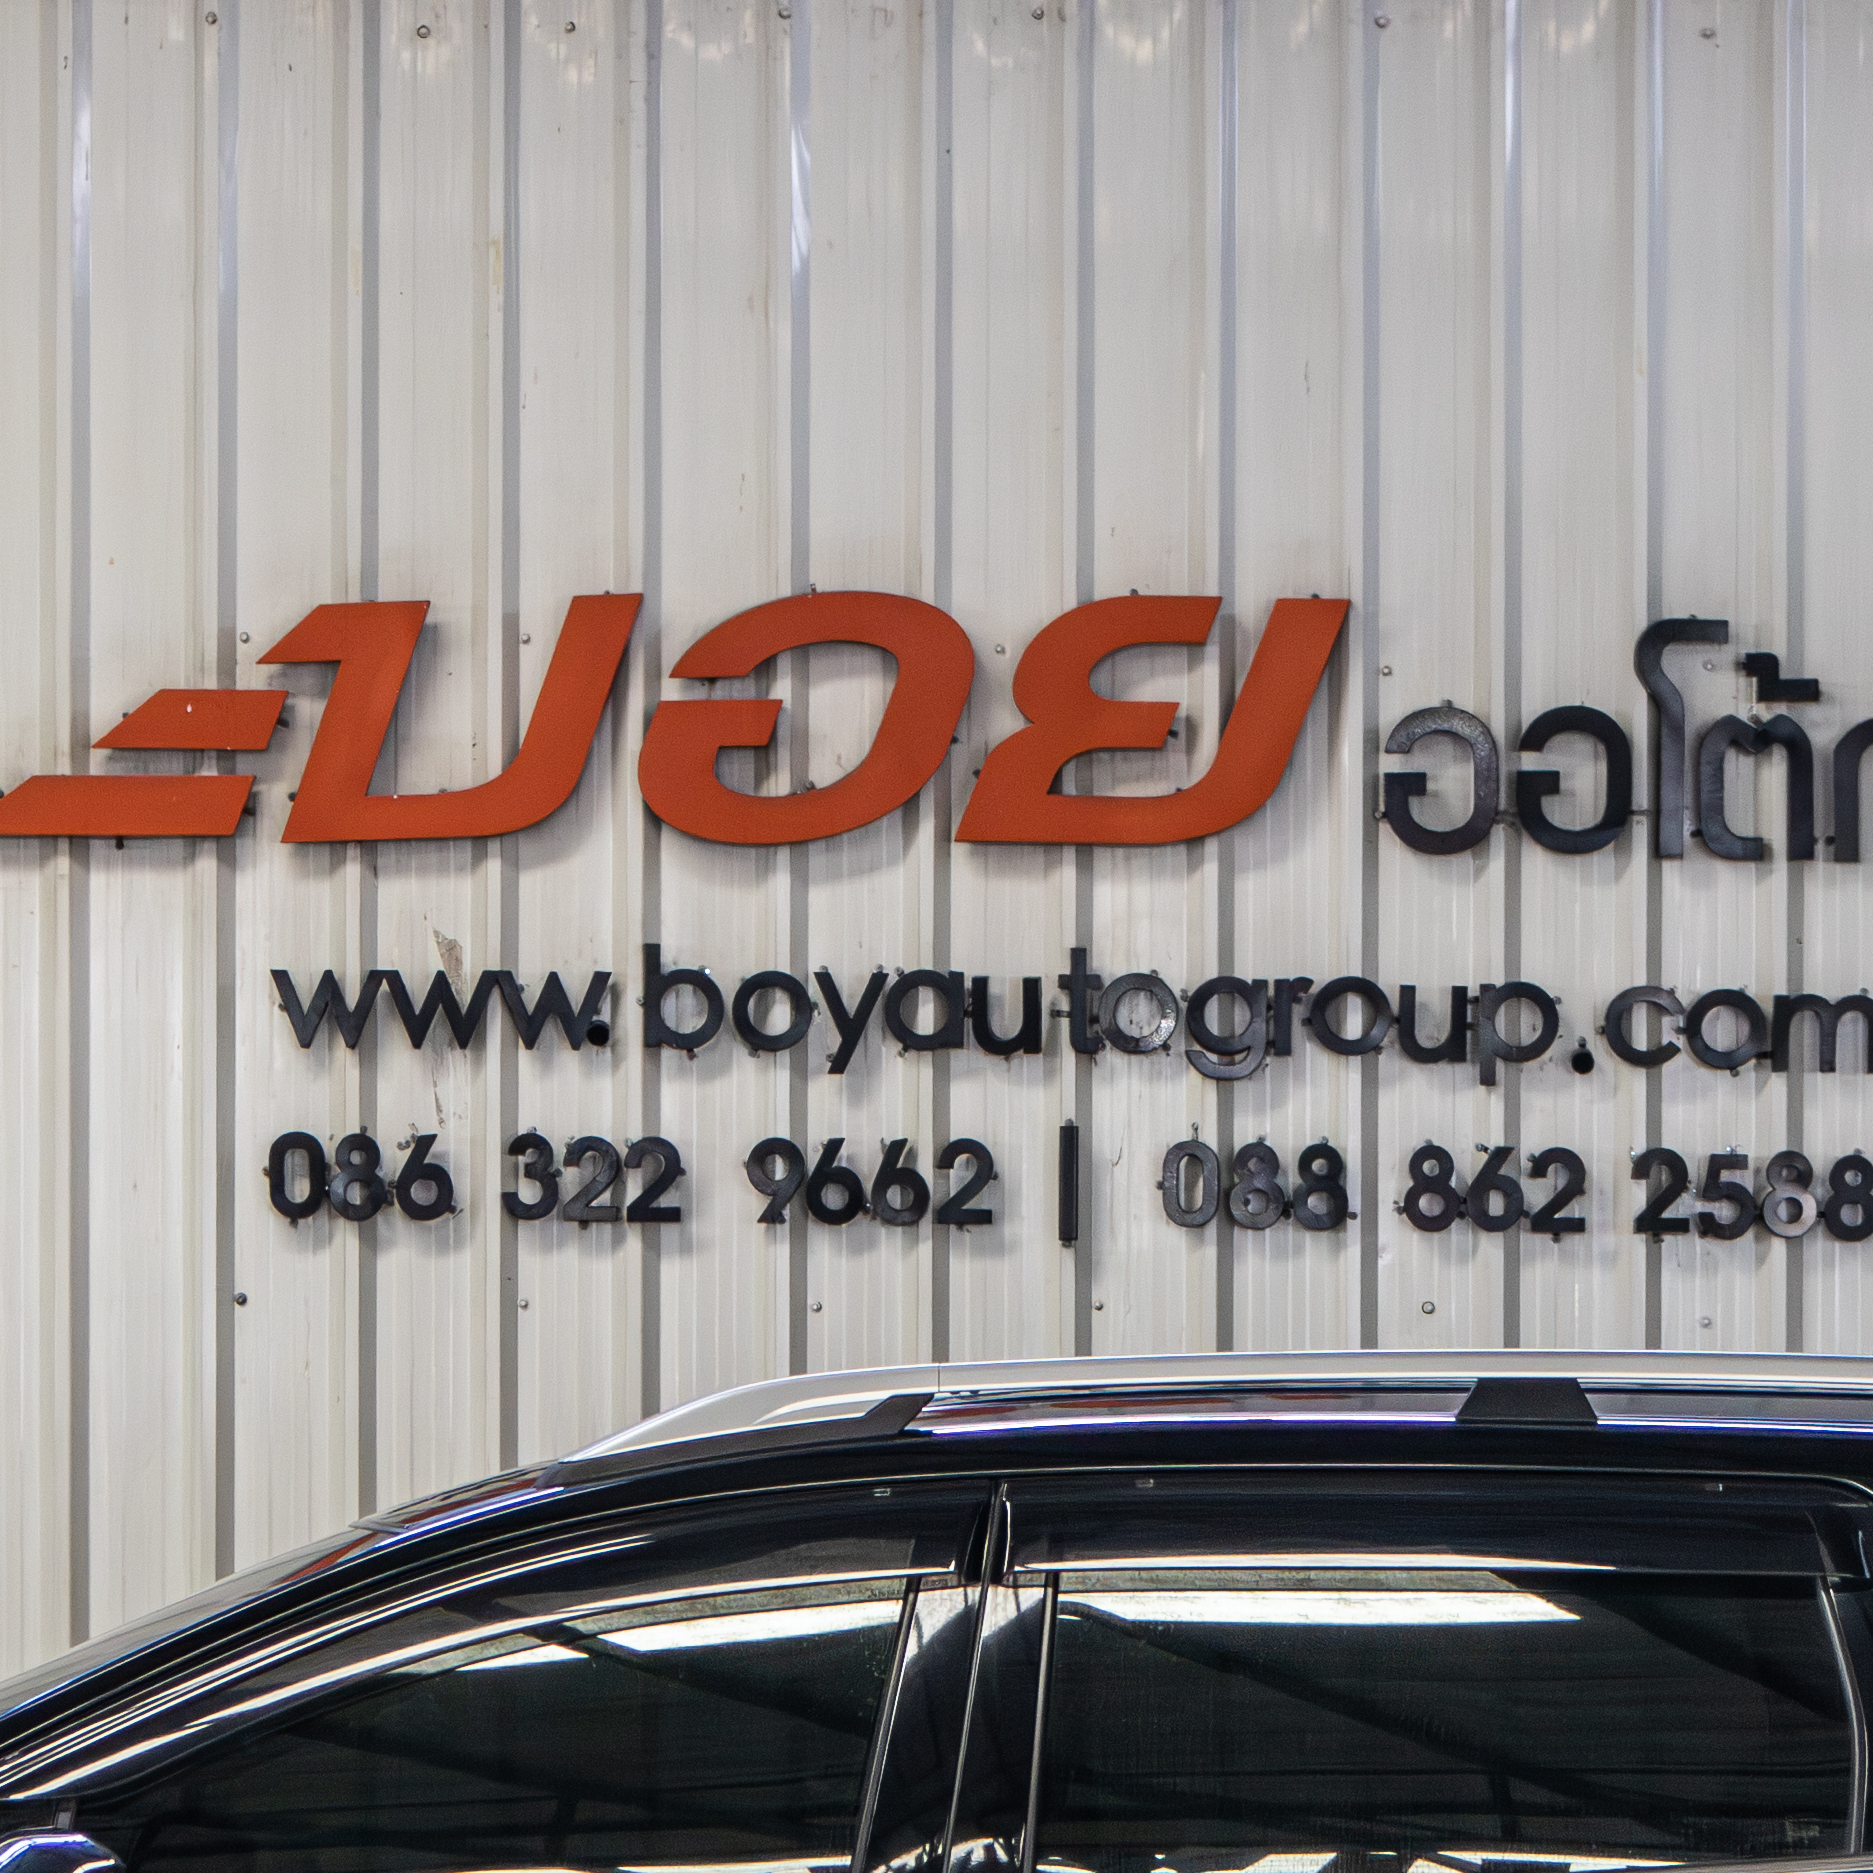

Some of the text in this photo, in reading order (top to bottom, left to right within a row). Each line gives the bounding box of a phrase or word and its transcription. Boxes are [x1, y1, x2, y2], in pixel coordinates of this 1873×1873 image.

[257, 592, 1351, 845] บอย
[266, 1130, 457, 1226] 086
[501, 1132, 685, 1228] 322
[746, 1137, 996, 1229] 9662
[1162, 1138, 1349, 1232] 088
[1403, 1143, 1586, 1238] 862
